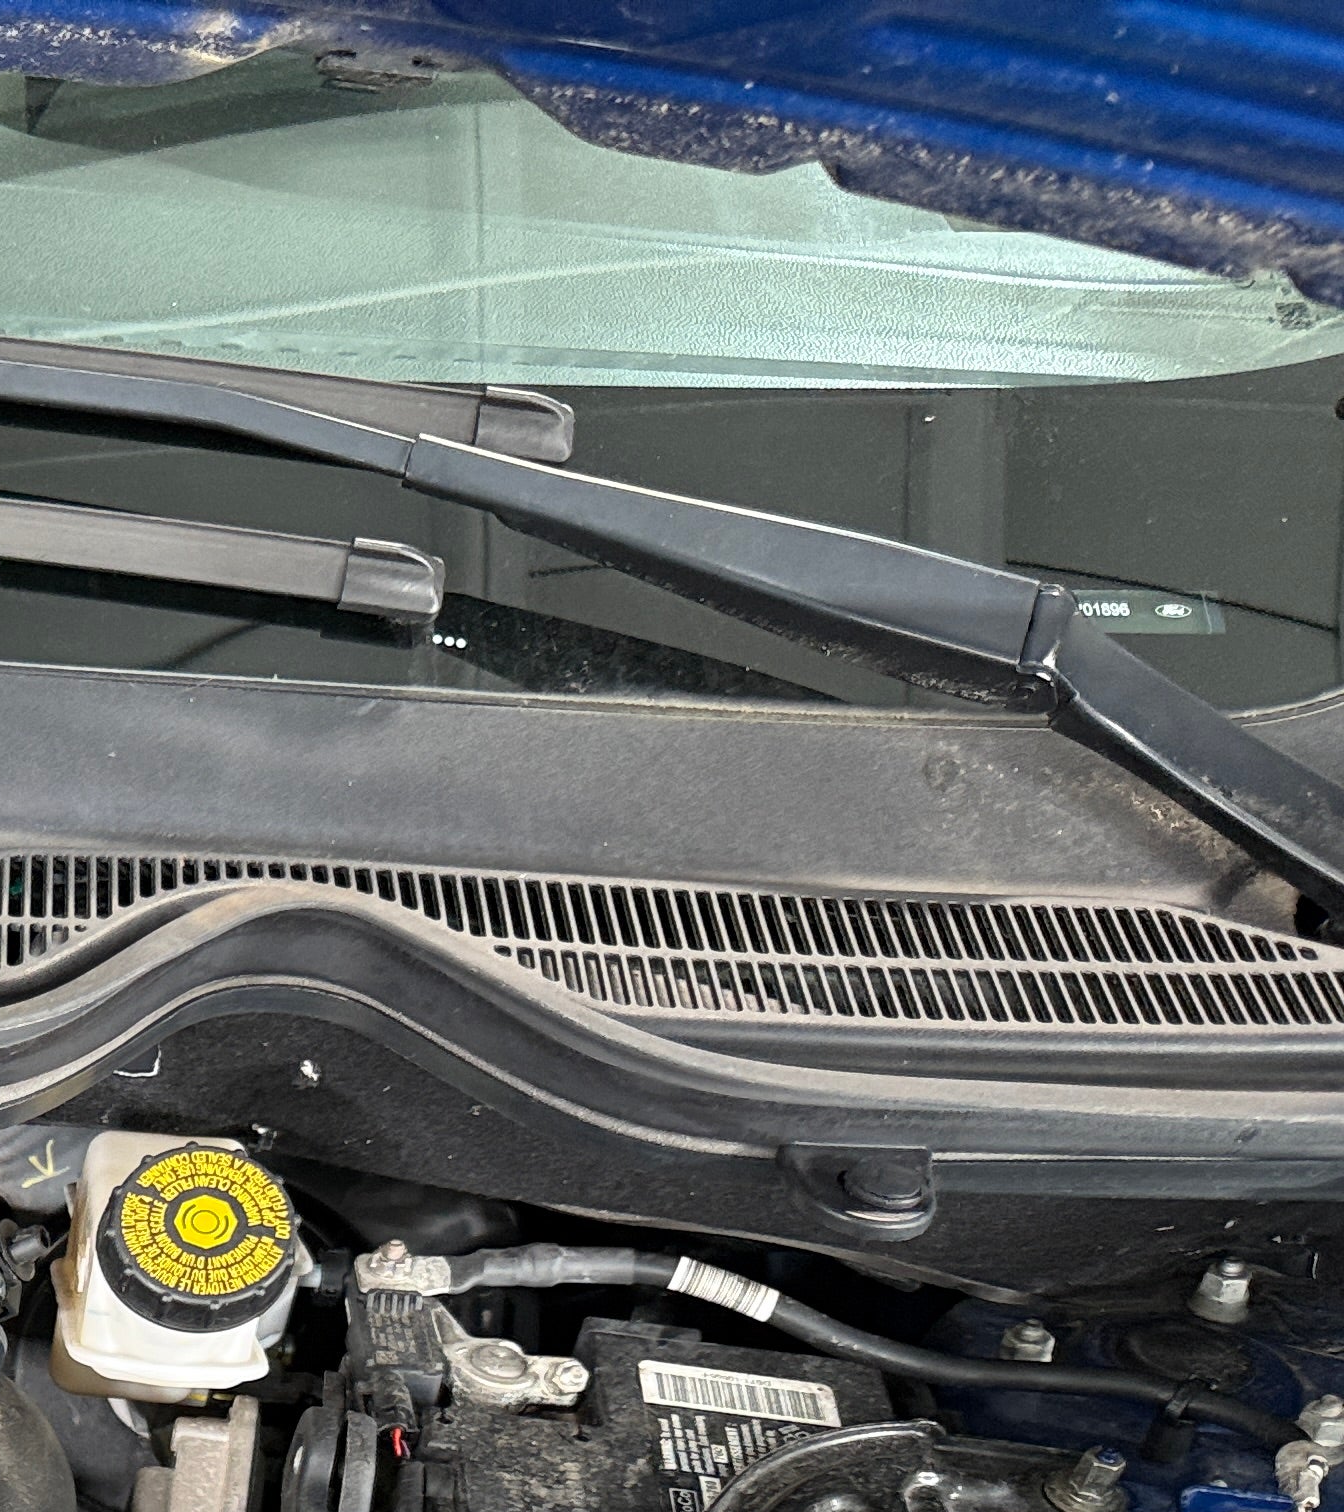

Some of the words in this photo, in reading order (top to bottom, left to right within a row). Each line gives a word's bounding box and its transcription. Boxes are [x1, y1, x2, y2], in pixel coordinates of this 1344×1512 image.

[191, 1152, 233, 1165] SEALED
[136, 1154, 189, 1187] CONTAINER
[153, 1172, 176, 1190] ONLY
[174, 1164, 194, 1176] USE
[195, 1163, 246, 1184] REMOVING
[243, 1163, 272, 1187] FROM
[160, 1178, 194, 1201] FILLER
[194, 1175, 230, 1191] CLEAN
[229, 1184, 261, 1226] WARNING
[178, 1254, 205, 1268] D'UN
[207, 1235, 260, 1270] PROVENANT
[136, 1255, 177, 1288] BOUCHON
[156, 1254, 190, 1278] LIQUIDE
[207, 1270, 228, 1281] QUE
[243, 1245, 284, 1285] ATTENTION
[193, 1278, 245, 1295] NETTOYER
